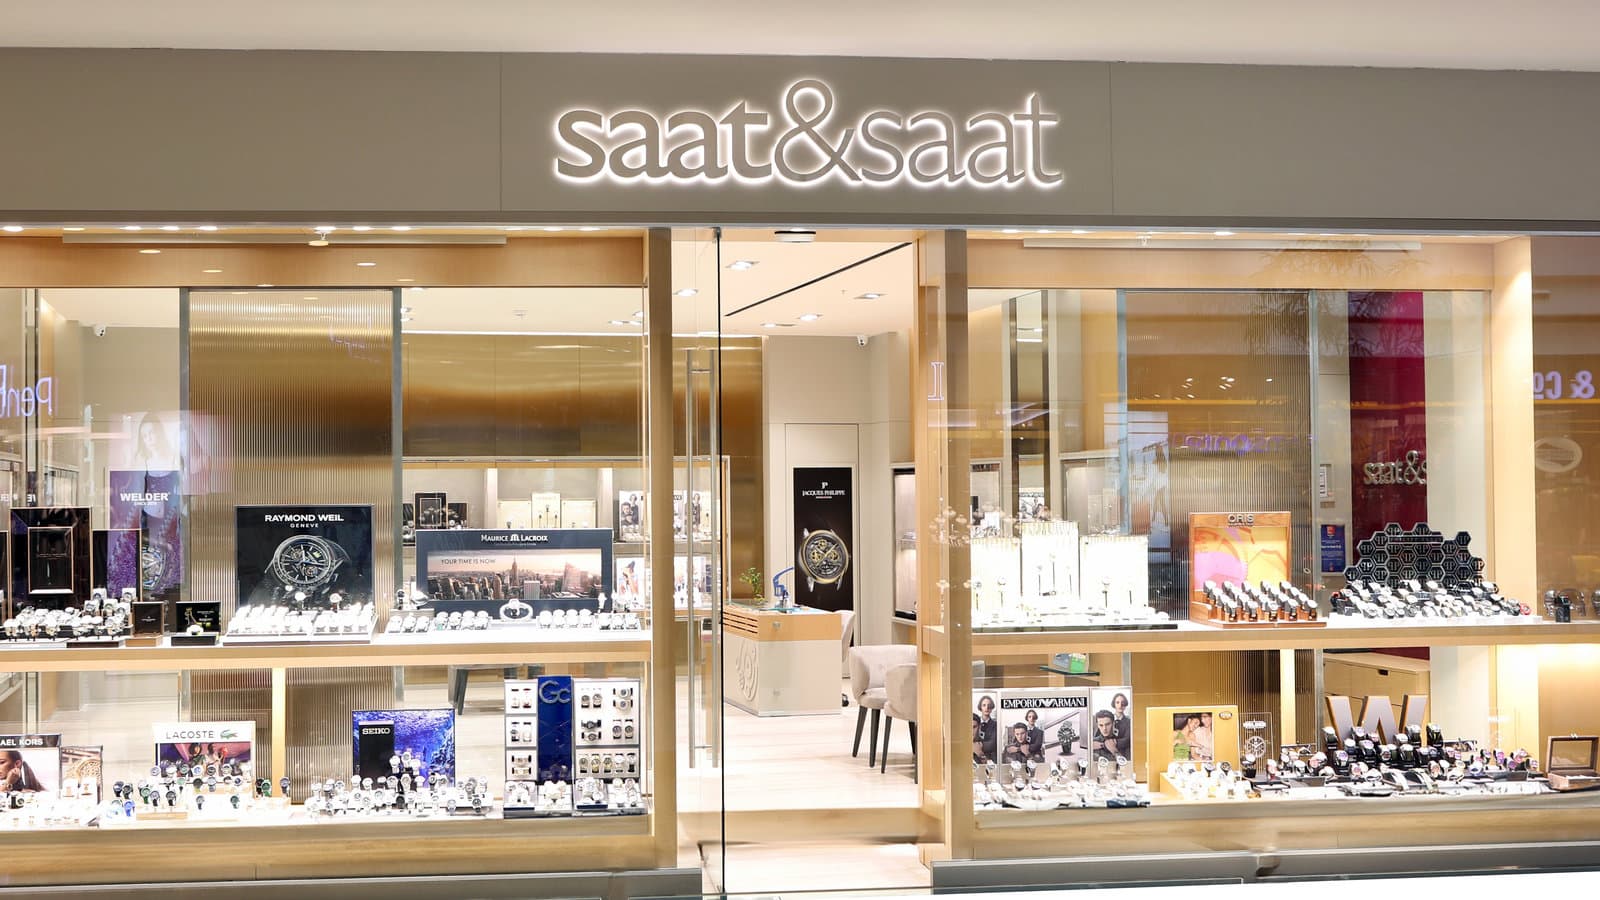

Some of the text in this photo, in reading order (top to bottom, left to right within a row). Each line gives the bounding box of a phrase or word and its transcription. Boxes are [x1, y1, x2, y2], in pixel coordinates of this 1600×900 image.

[557, 79, 1063, 184] saat&saat
[120, 492, 169, 502] WELDER
[264, 514, 344, 522] RAYMOND WEIL
[1228, 514, 1254, 523] ORIS
[481, 534, 509, 542] MAURICE
[520, 534, 549, 542] LACROIX
[1003, 698, 1085, 708] EMPORIO ARMANI
[166, 730, 214, 739] LACOSTE
[362, 727, 390, 735] SEIKO
[19, 738, 44, 746] KORS
